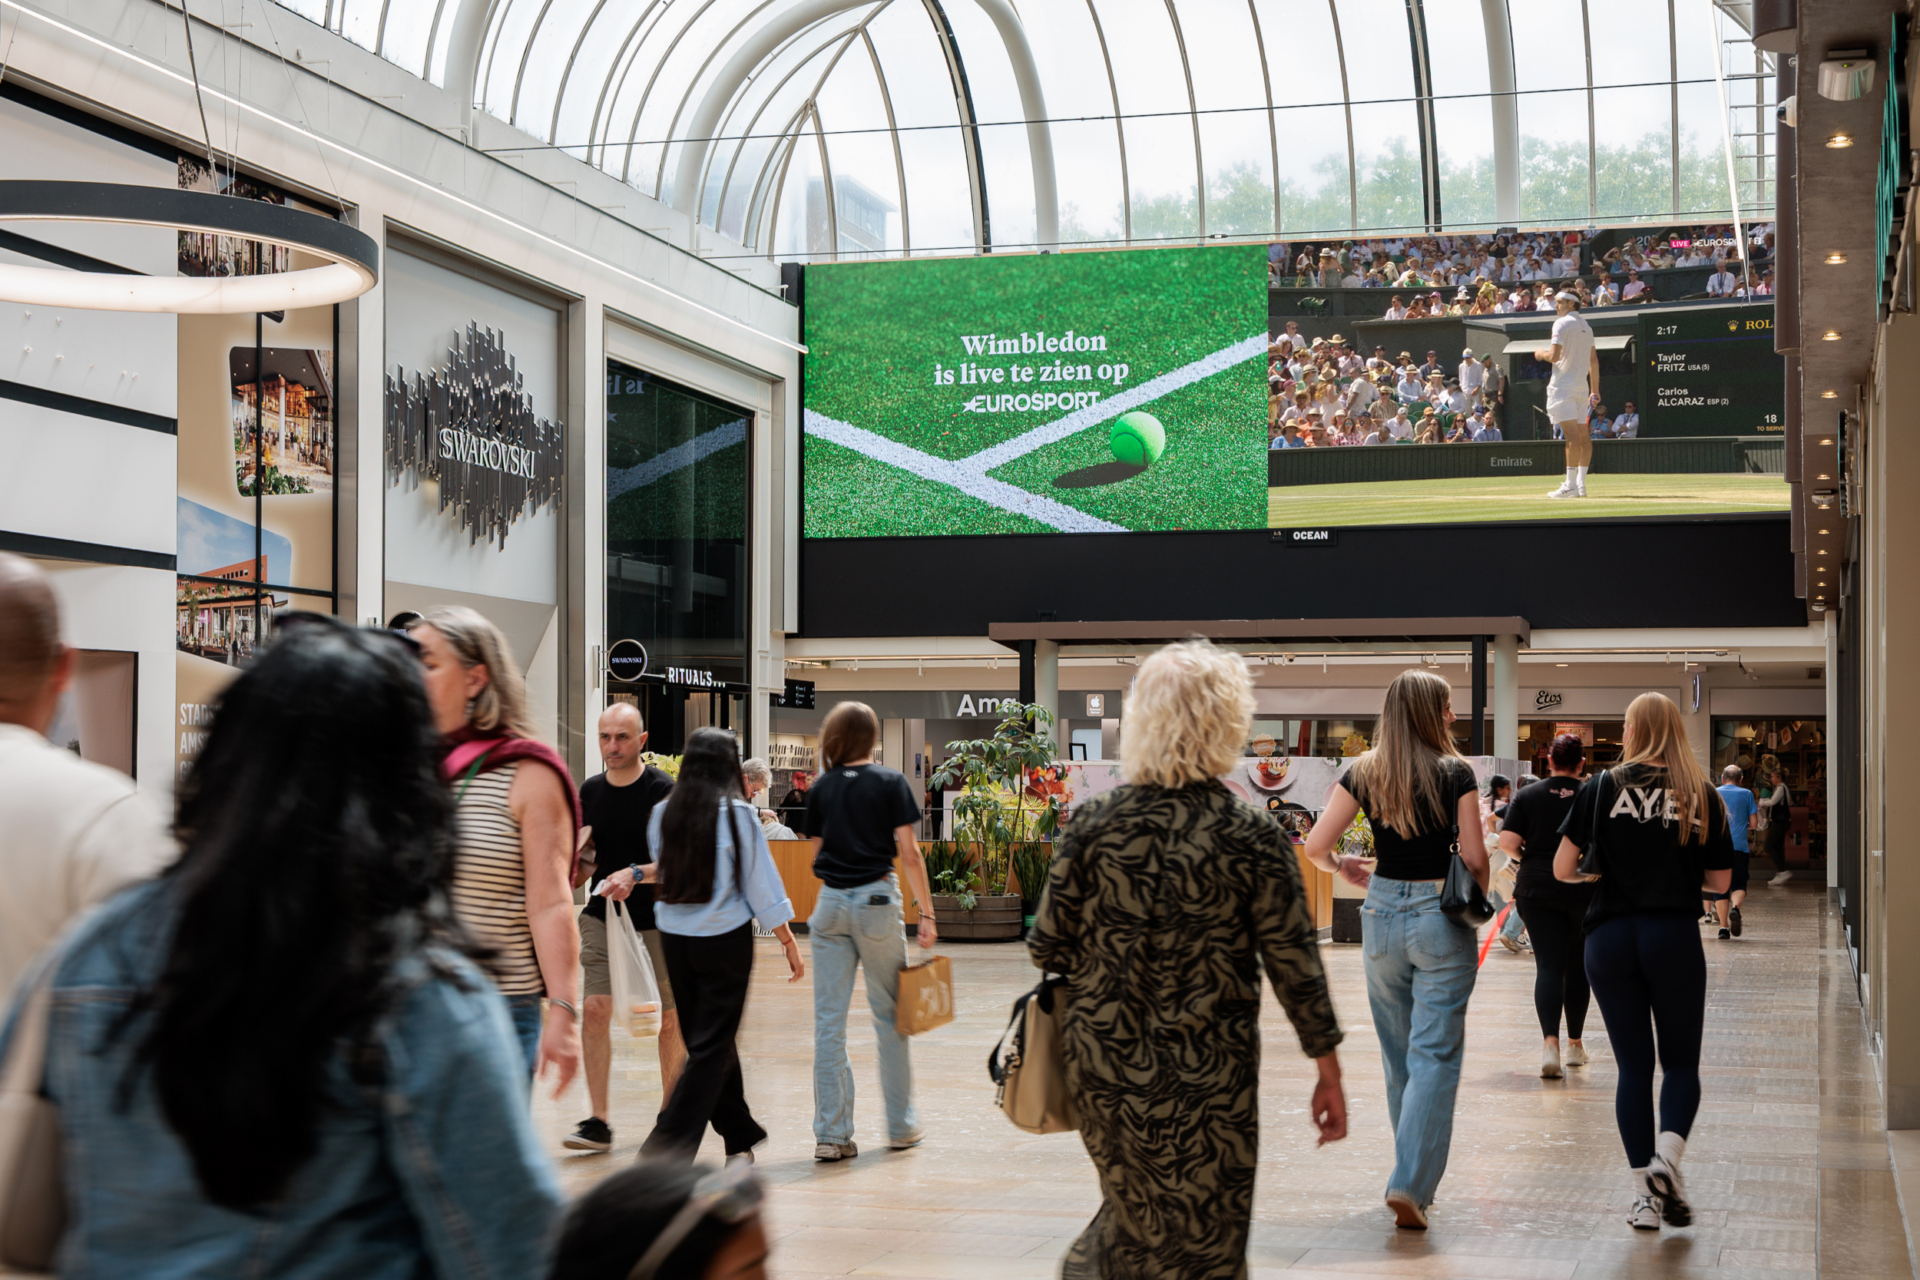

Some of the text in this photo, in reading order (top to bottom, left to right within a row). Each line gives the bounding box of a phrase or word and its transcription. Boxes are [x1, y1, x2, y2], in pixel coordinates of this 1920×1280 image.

[1694, 237, 1752, 247] EUROSPT
[1745, 320, 1774, 330] ROL
[1657, 326, 1677, 335] 2:17
[961, 330, 1107, 355] Wimbledon
[1657, 353, 1686, 362] Taylor
[934, 360, 1129, 385] is live te zien op
[1657, 363, 1685, 372] FRITZ
[1657, 387, 1688, 396] Carlos
[962, 391, 1100, 413] EUROSPORT
[1657, 397, 1704, 407] ALCARAZ
[1721, 398, 1729, 406] (2)
[1764, 414, 1777, 423] 18
[439, 428, 536, 479] SWAROVSKI
[1490, 456, 1533, 467] Emirates
[1293, 530, 1329, 540] OCEAN
[1536, 690, 1562, 704] Etos
